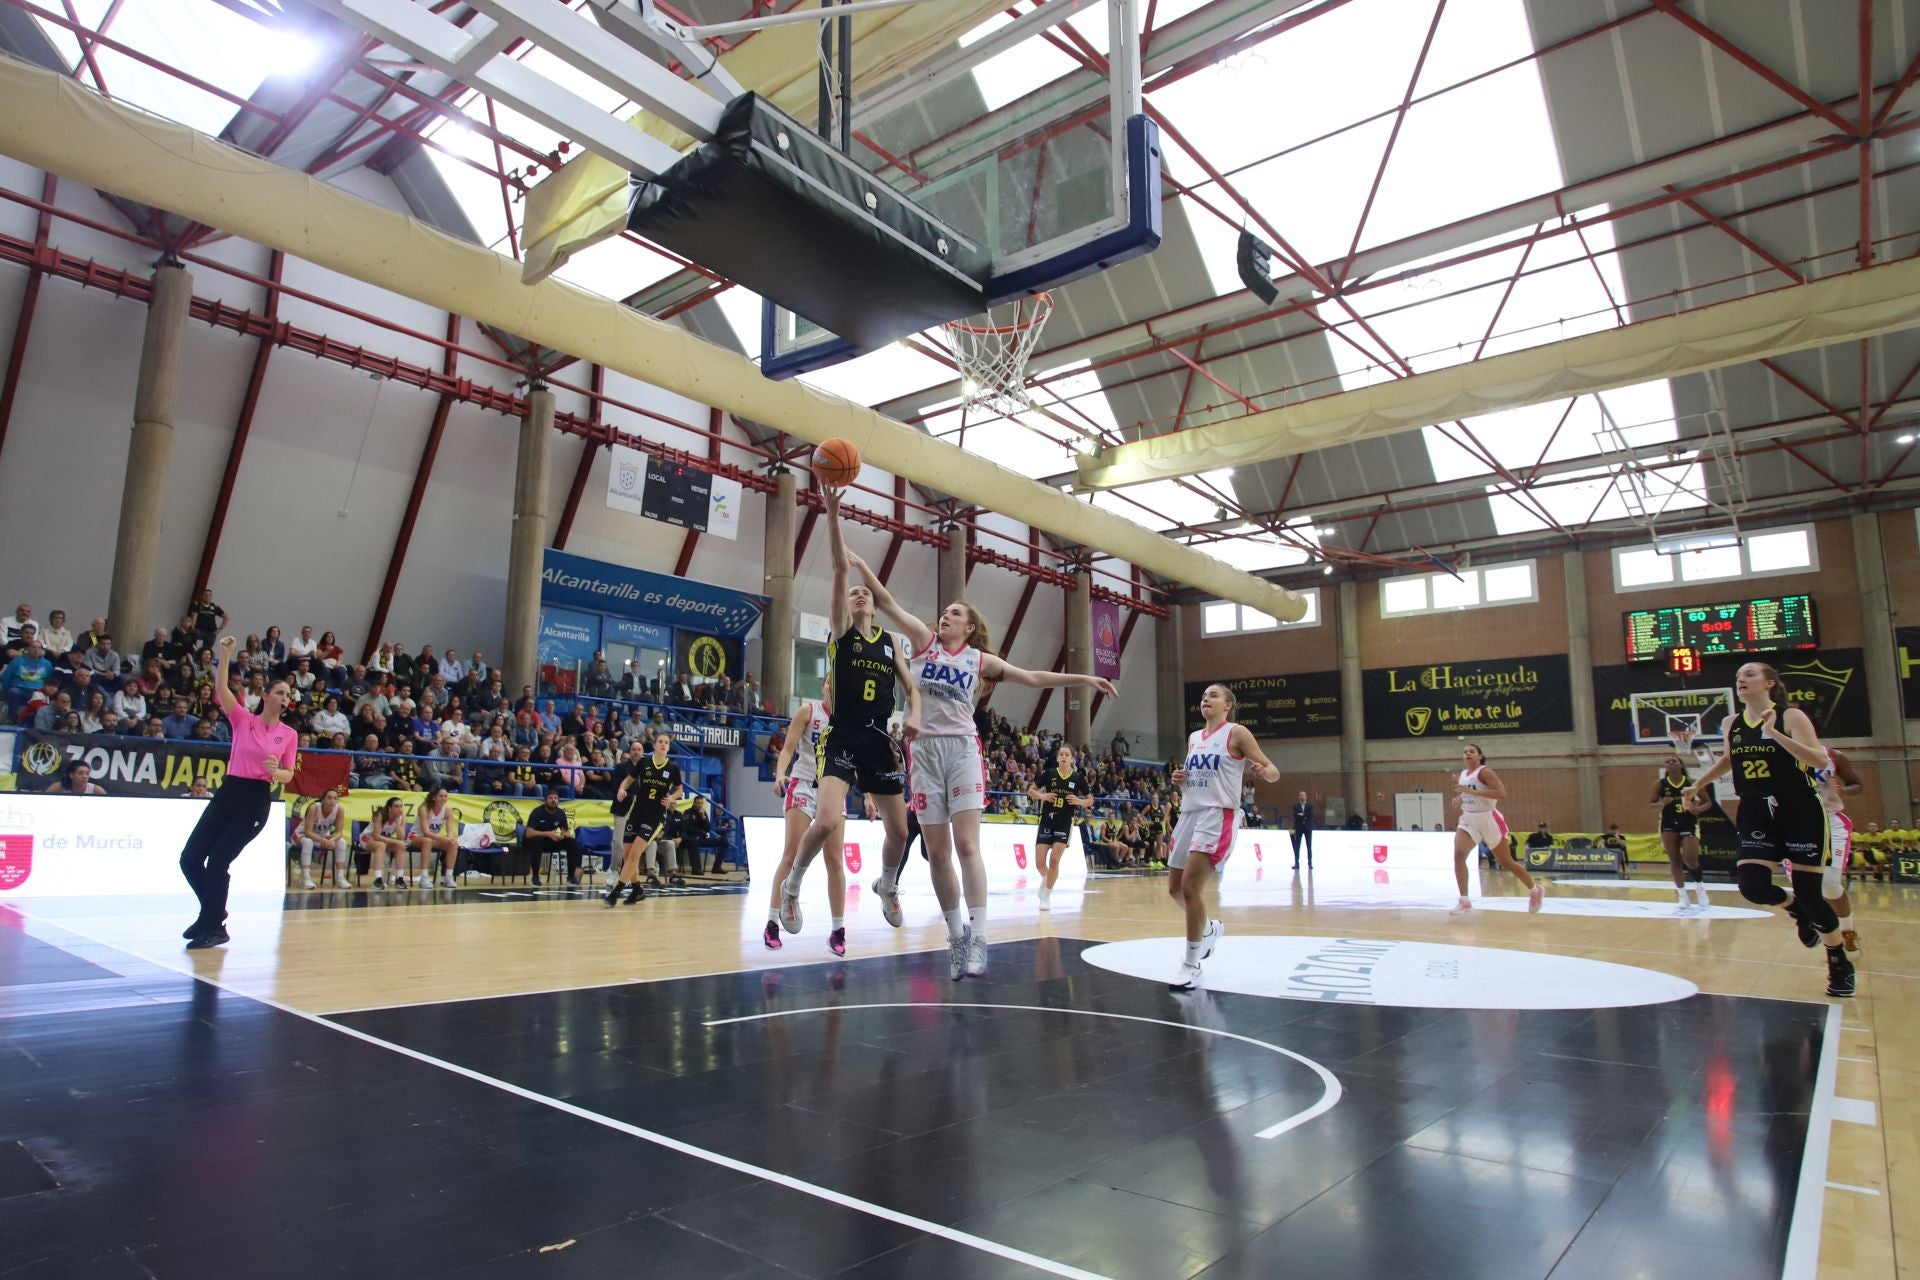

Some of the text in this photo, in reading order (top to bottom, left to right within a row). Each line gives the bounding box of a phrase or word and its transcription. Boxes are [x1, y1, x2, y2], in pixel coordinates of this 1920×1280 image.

[648, 472, 666, 484] LOCAL
[542, 567, 727, 617] Alcantarilla es deporte
[1688, 612, 1706, 622] 60
[1719, 608, 1737, 619] 57
[544, 626, 590, 642] Alcantarilla
[1702, 621, 1732, 632] 5:05
[852, 658, 892, 675] HOZONO
[1674, 656, 1692, 671] 19
[922, 662, 972, 689] BAXI
[1388, 665, 1539, 693] La Hacienda
[863, 679, 876, 702] 6
[1230, 678, 1287, 690] HOZONO
[1611, 694, 1708, 710] Alcantarilla
[1438, 700, 1522, 722] la boca te lía
[1732, 745, 1776, 755] HOZONO
[1186, 754, 1220, 770] AXI
[1742, 760, 1771, 780] 22
[161, 754, 230, 790] JAIR
[648, 788, 656, 800] 2
[1054, 797, 1064, 808] 19
[42, 834, 144, 850] de Murcia
[1278, 938, 1400, 1004] HOZONO
